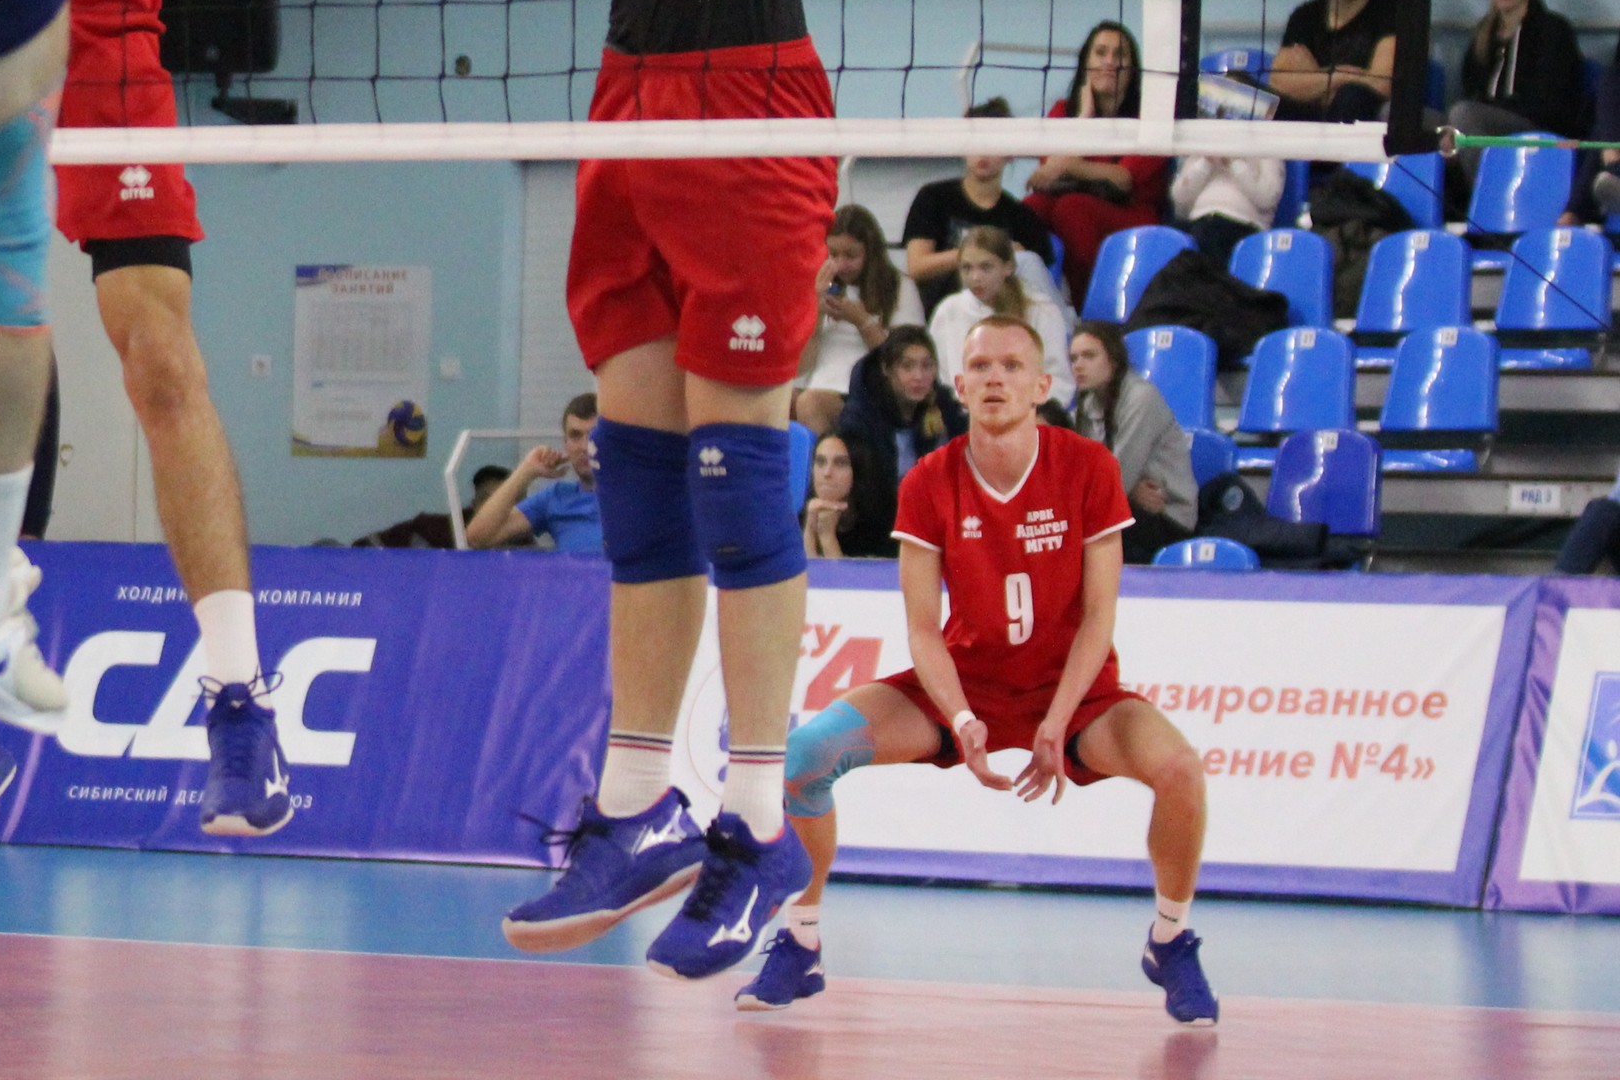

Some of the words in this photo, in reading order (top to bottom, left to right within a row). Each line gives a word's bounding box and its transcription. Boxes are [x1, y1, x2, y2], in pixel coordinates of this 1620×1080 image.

[1025, 534, 1064, 553] МГТУ
[258, 589, 363, 607] КОМПАНИЯ
[1005, 571, 1035, 646] 9
[1120, 681, 1450, 724] изированное
[1197, 745, 1317, 778] ение
[68, 785, 168, 803] СИБИРСКИЙ
